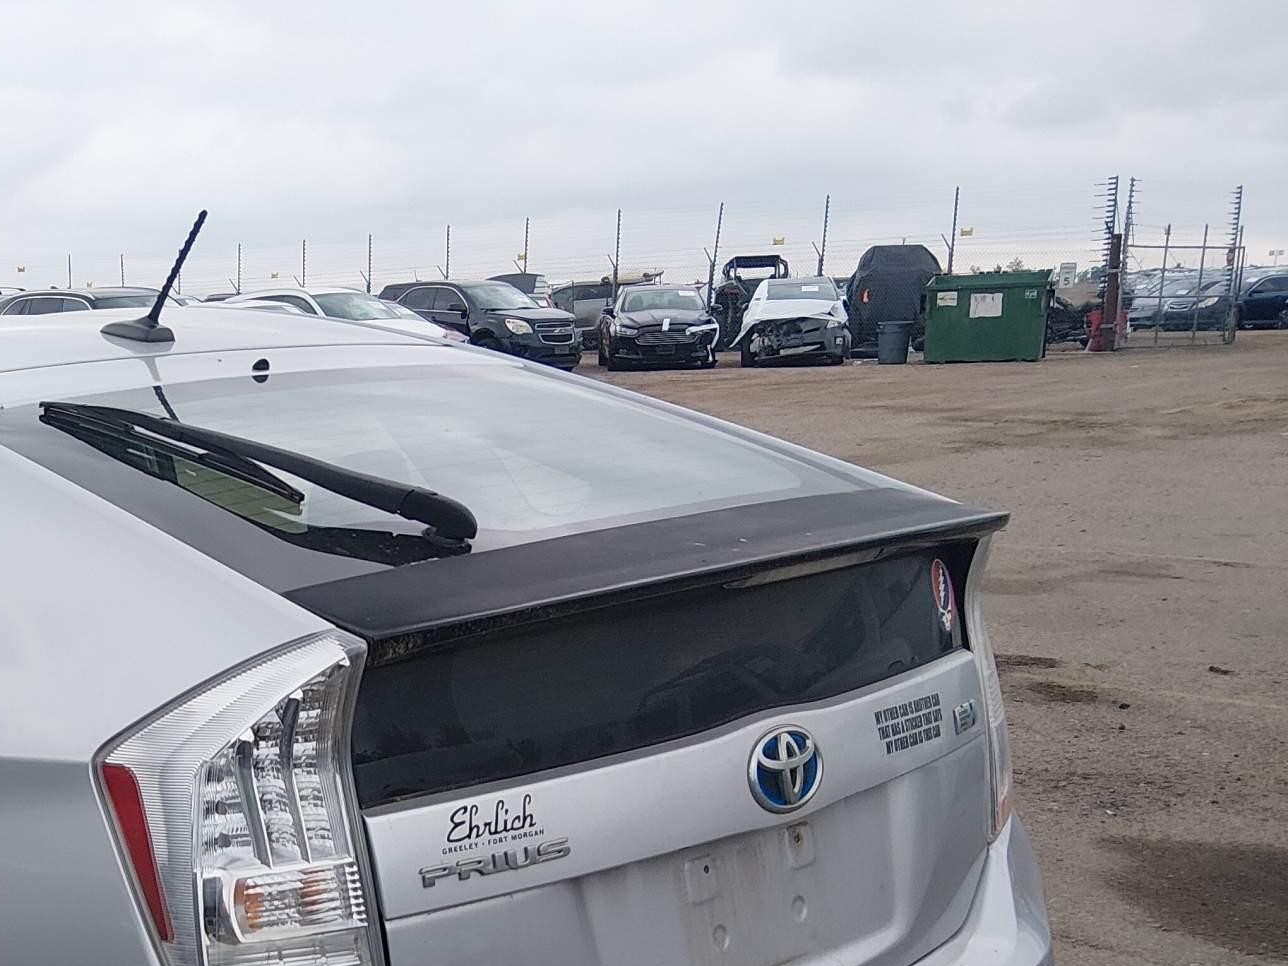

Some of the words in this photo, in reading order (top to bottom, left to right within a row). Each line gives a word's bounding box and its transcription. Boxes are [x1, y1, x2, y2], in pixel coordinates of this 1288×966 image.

[874, 710, 884, 725] MY
[883, 706, 900, 722] OTHER
[898, 703, 909, 718] CAR
[931, 692, 941, 707] CAR
[878, 725, 891, 741] THAT
[891, 722, 901, 737] HAS
[904, 714, 923, 732] STICKER
[922, 711, 933, 726] THAT
[932, 707, 943, 723] SAYS
[885, 740, 894, 755] MY
[893, 735, 909, 752] OTHER
[908, 732, 919, 748] CAR
[922, 727, 933, 742] THIS
[932, 723, 942, 739] CAR
[446, 794, 537, 843] Ehrlich
[441, 841, 479, 855] GREELEY
[487, 835, 508, 846] FORT
[510, 828, 545, 841] MORGAN
[418, 836, 572, 888] PRIUS
